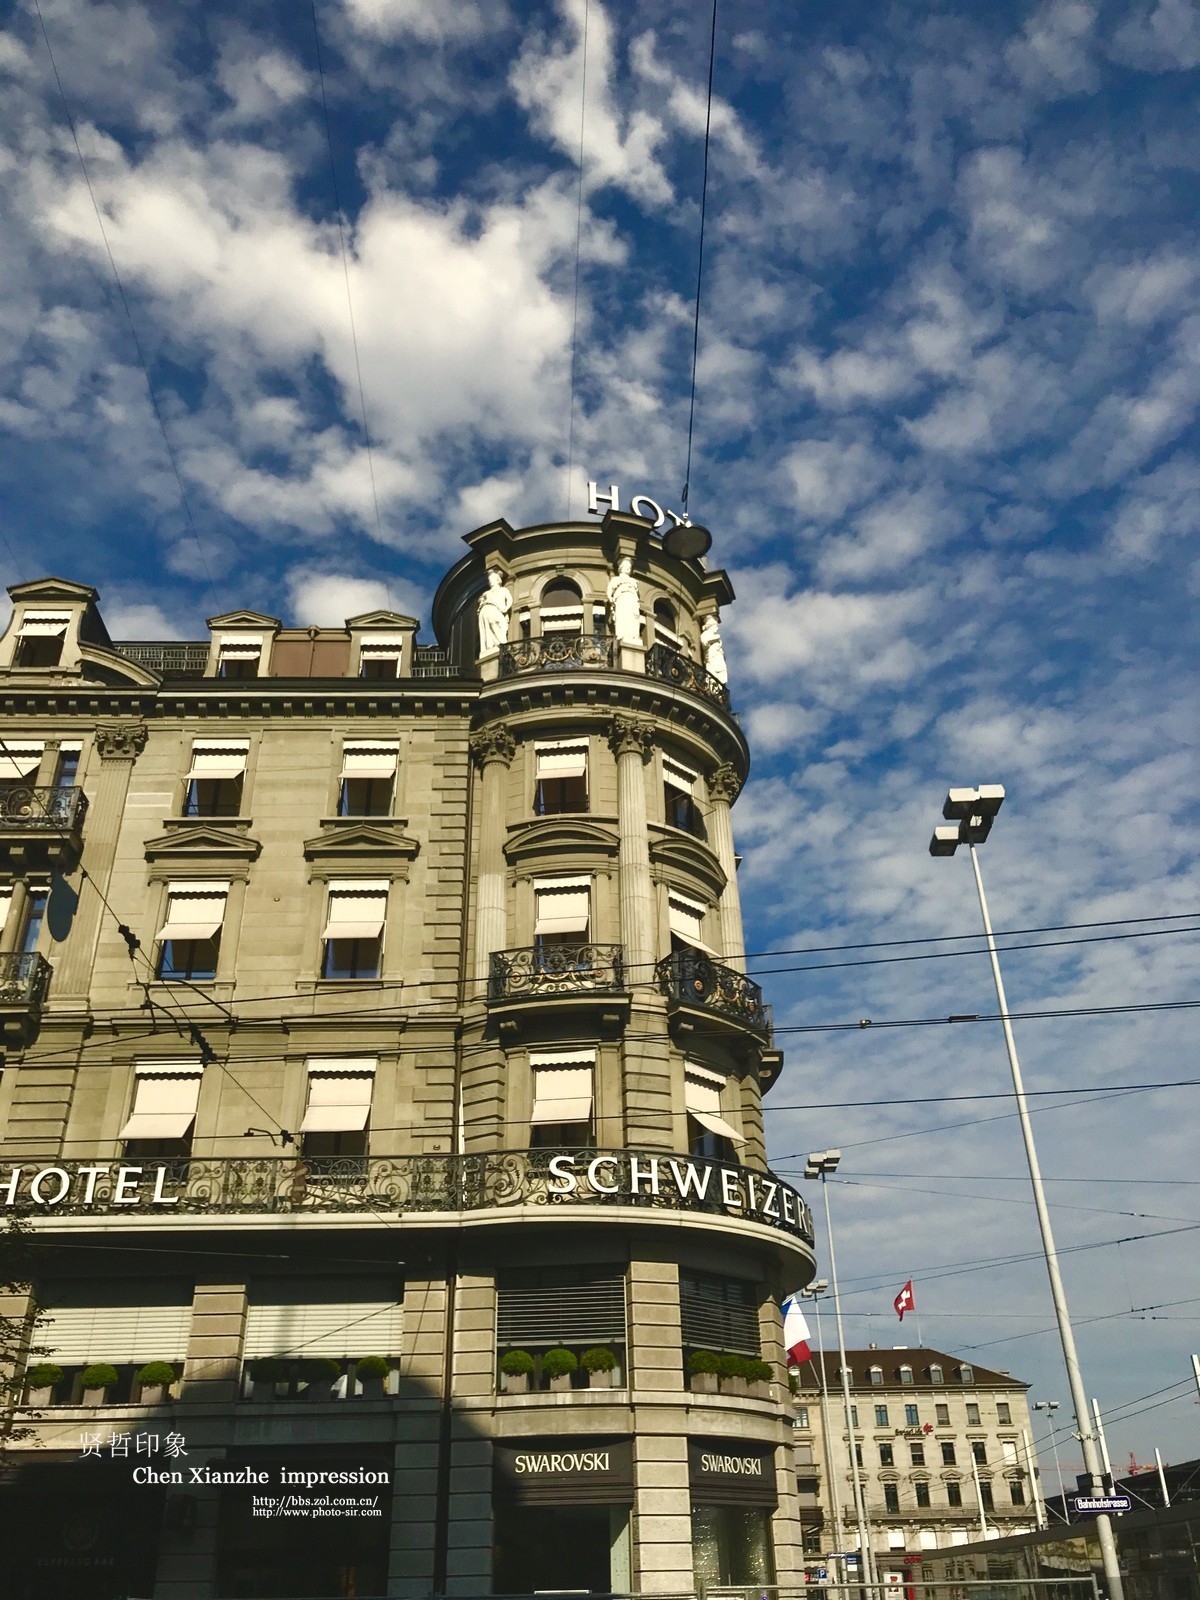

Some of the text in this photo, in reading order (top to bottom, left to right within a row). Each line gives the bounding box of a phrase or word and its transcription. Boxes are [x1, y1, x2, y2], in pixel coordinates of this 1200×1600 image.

[0, 1166, 179, 1206] HOTEL
[514, 1452, 610, 1473] SWAROVSKI
[701, 1453, 762, 1476] SWAROVSKI
[1077, 1499, 1128, 1509] Bahnhofstrasse
